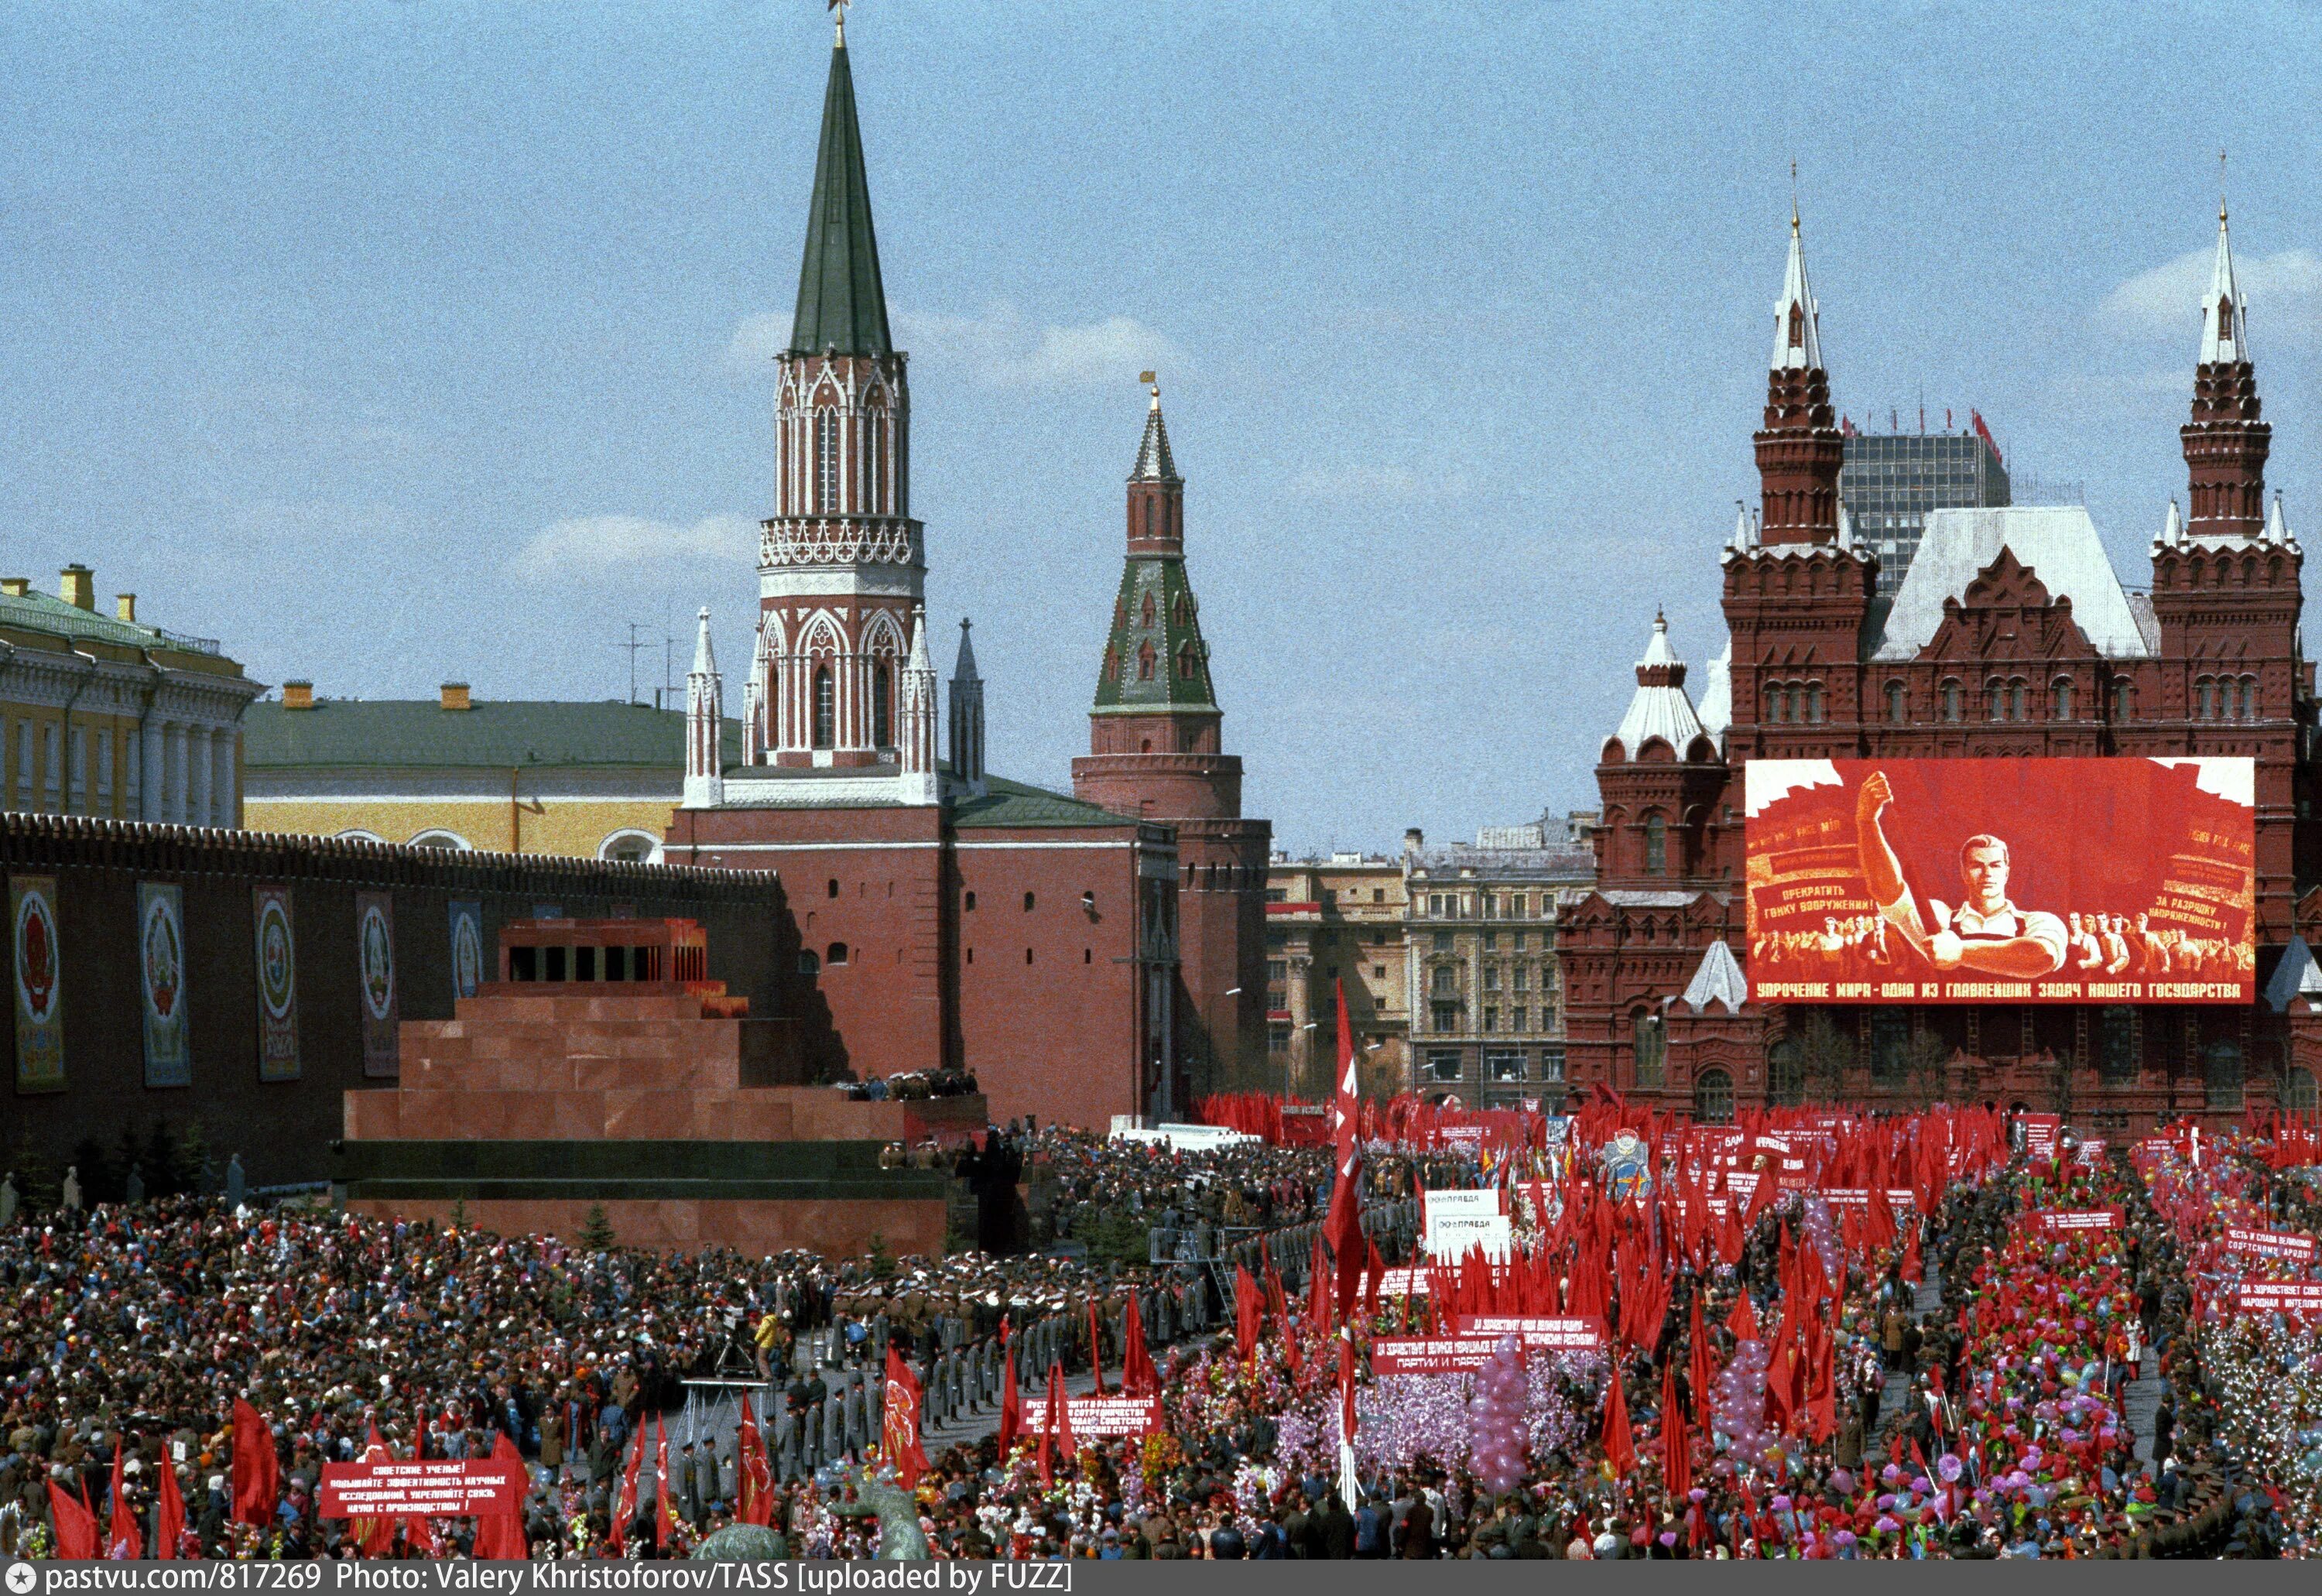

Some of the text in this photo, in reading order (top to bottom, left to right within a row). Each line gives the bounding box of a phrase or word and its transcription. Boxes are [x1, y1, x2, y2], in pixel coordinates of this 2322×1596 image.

[1782, 885, 1845, 901] ПРЕКРАТИТЬ
[1764, 902, 1796, 919] ГОНКУ
[2156, 896, 2217, 916] ЗА РАЗРЯДКУ
[1757, 982, 1829, 998] УПРОЧЕНИЕ
[1836, 982, 1871, 998] МИРА
[1882, 982, 1915, 998] ОДНА
[1922, 982, 1939, 998] ИЗ
[1946, 981, 2032, 998] ГЛАВНЕЙШИХ
[2039, 982, 2081, 998] ЗАДАЧ
[2088, 982, 2142, 998] НАШЕГО
[2149, 982, 2241, 998] ГОСУДАРСТВА
[1725, 1133, 1744, 1147] БАМ
[2229, 1230, 2248, 1240] ЧЕСТЬ
[2256, 1234, 2277, 1244] СЛАВА
[2283, 1248, 2311, 1259] АРОДУ!
[2241, 1284, 2252, 1294] ДА
[2253, 1285, 2301, 1295] ЗДРАВСТВУЕТ
[2241, 1298, 2279, 1308] НАРОДНАЯ
[1377, 1343, 1385, 1355] ДА
[1397, 1358, 1438, 1368] ПАРТИИ
[1441, 1358, 1449, 1367] И
[372, 1461, 465, 1475] СОВЕТСКИЕ УЧЕНЫЕ!
[330, 1475, 505, 1488] ПОВЫШАЙТЕ ЭФФЕКТИВНОСТЬ НАУЧНЫХ
[338, 1488, 496, 1501] ИССЛЕДОВАНИЙ, УКРЕПЛЯЙТЕ СВЯЗЬ
[347, 1504, 375, 1513] НАУКИ
[377, 1504, 383, 1512] С
